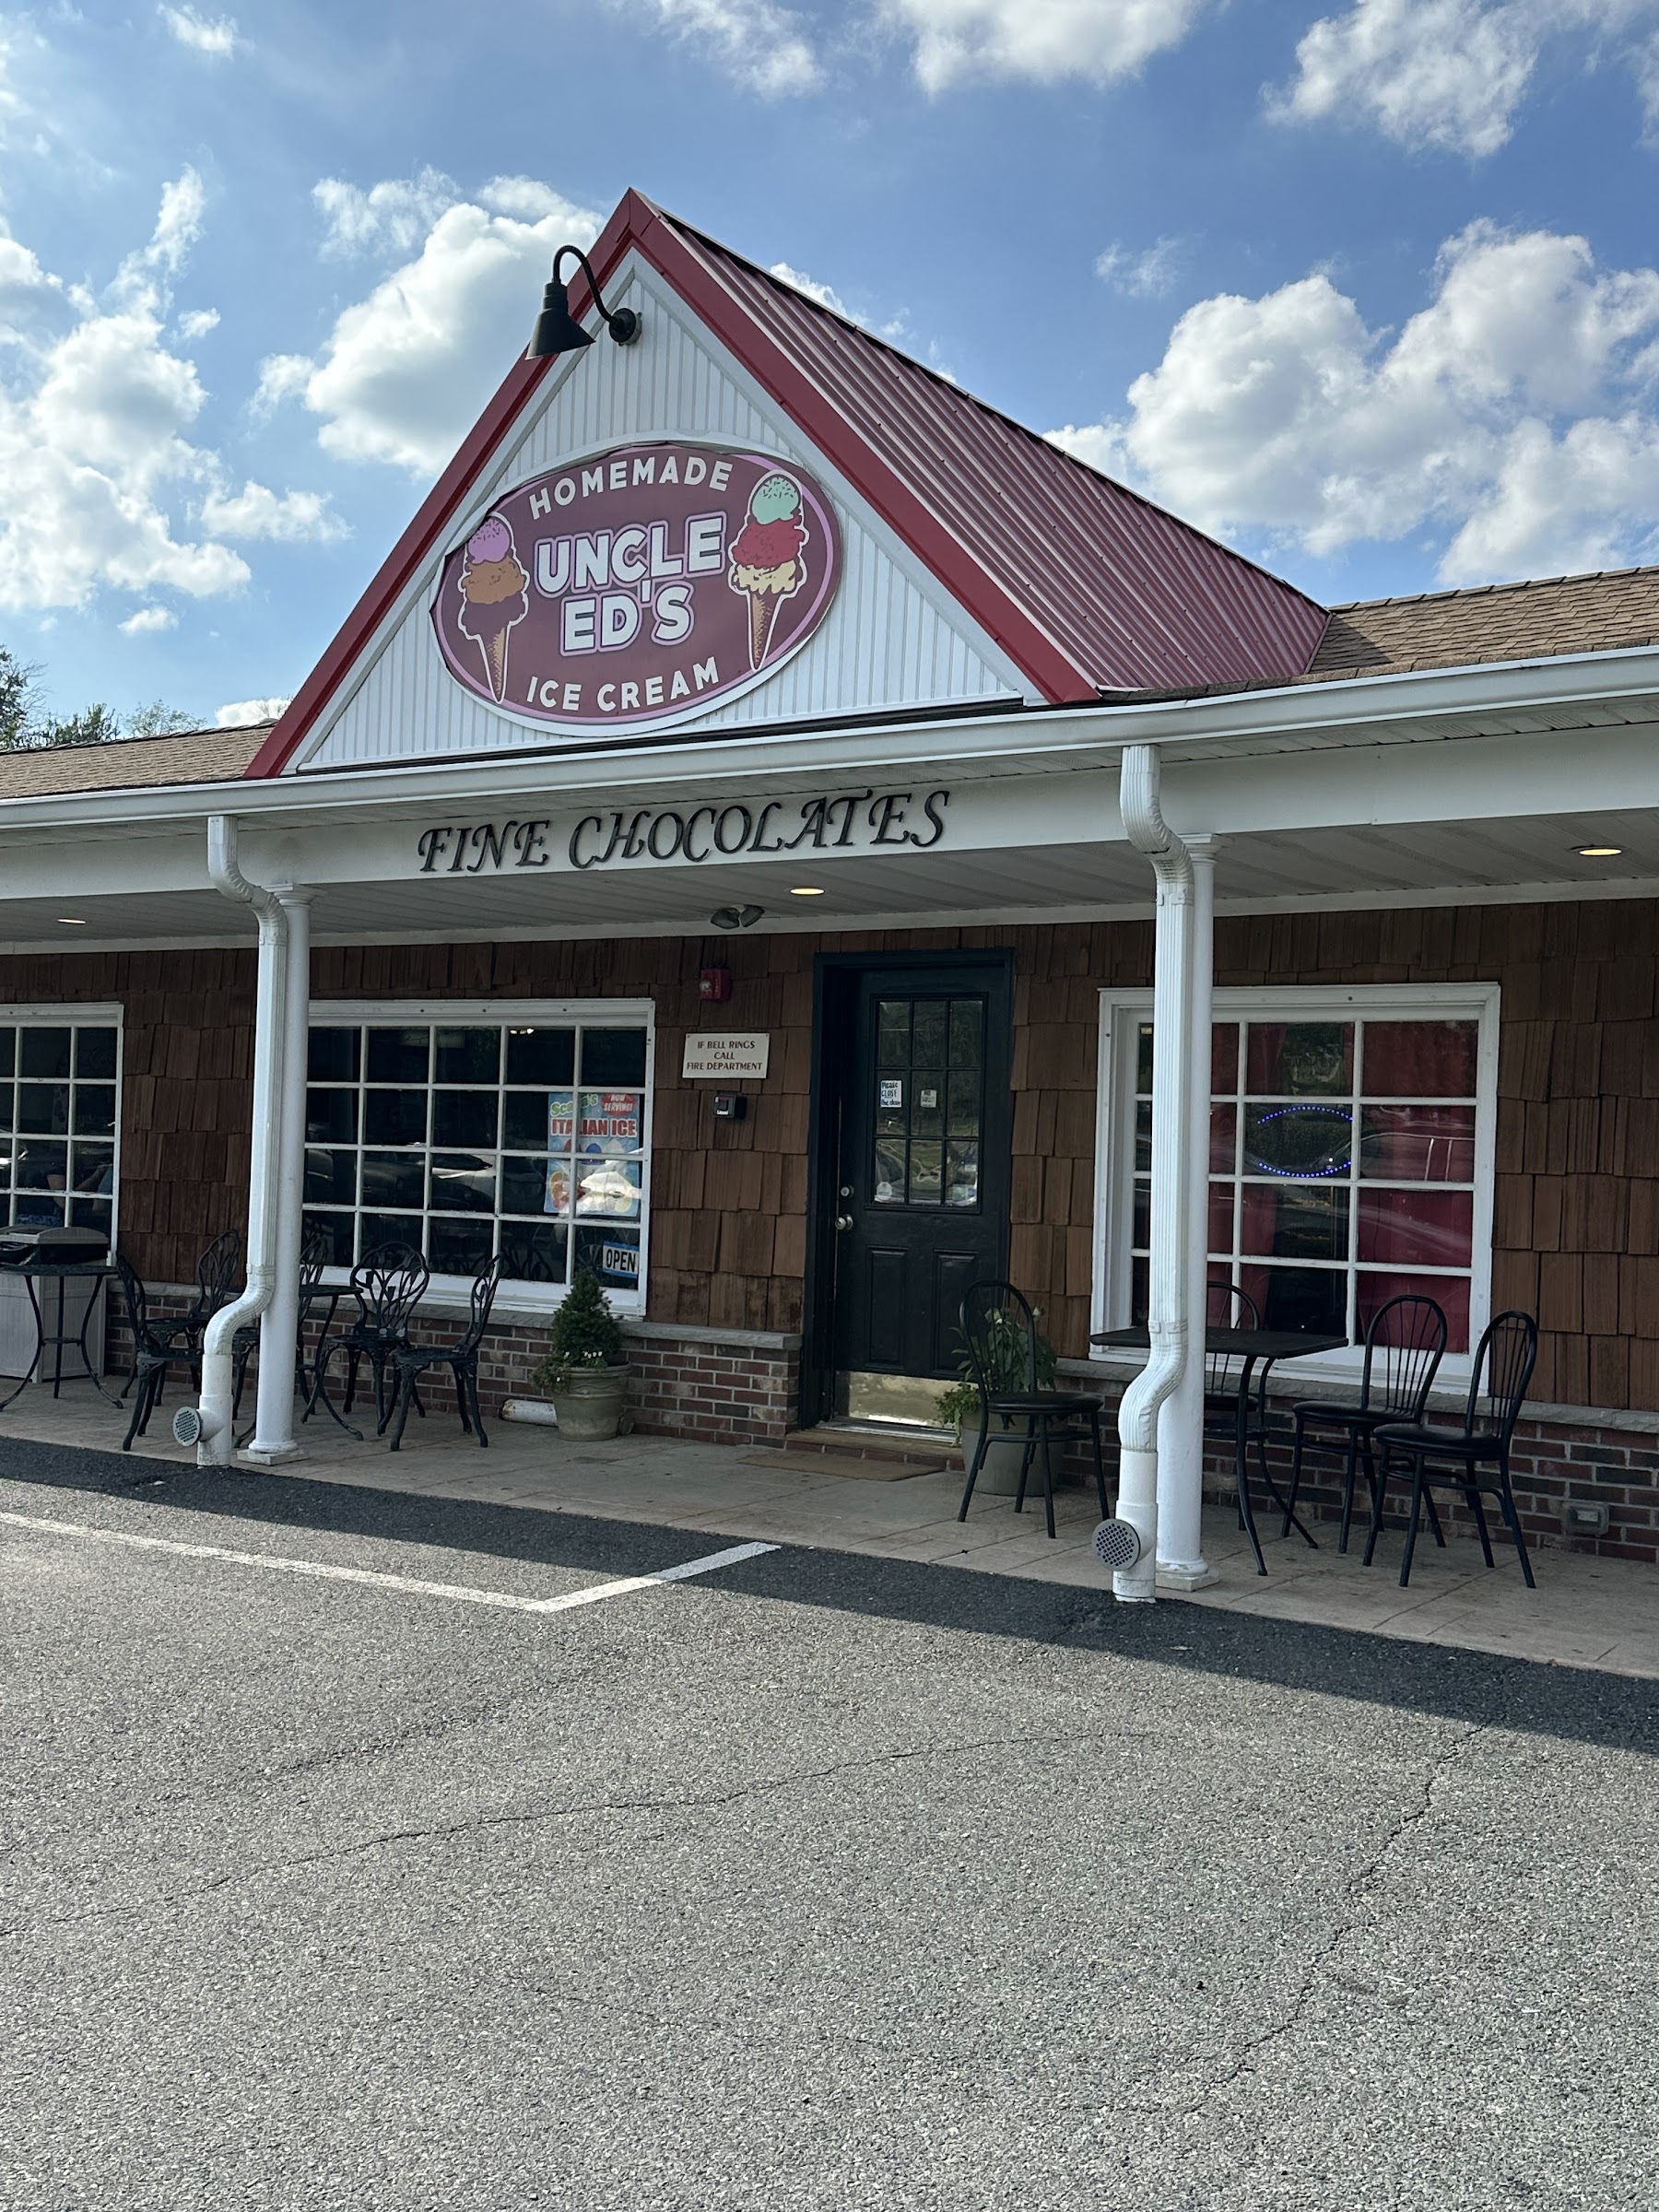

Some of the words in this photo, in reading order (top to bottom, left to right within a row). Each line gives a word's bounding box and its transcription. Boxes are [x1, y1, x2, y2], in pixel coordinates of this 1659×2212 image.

[528, 455, 734, 520] HOMEMADE
[535, 514, 724, 595] UNCLE
[562, 577, 692, 653] ED'S
[526, 676, 582, 712] ICE
[596, 655, 720, 712] CREAM
[418, 818, 552, 873] FINE
[569, 789, 951, 869] CHOCOLATES
[697, 1041, 705, 1049] IF
[707, 1041, 726, 1049] BELL
[729, 1041, 756, 1049] RINGS
[713, 1052, 735, 1060] CALL
[687, 1062, 704, 1070] FIRE
[707, 1062, 763, 1070] DEPARTMENT
[552, 1118, 608, 1136] ITAIAN
[611, 1119, 637, 1137] ICE
[606, 1249, 636, 1273] OPEN
